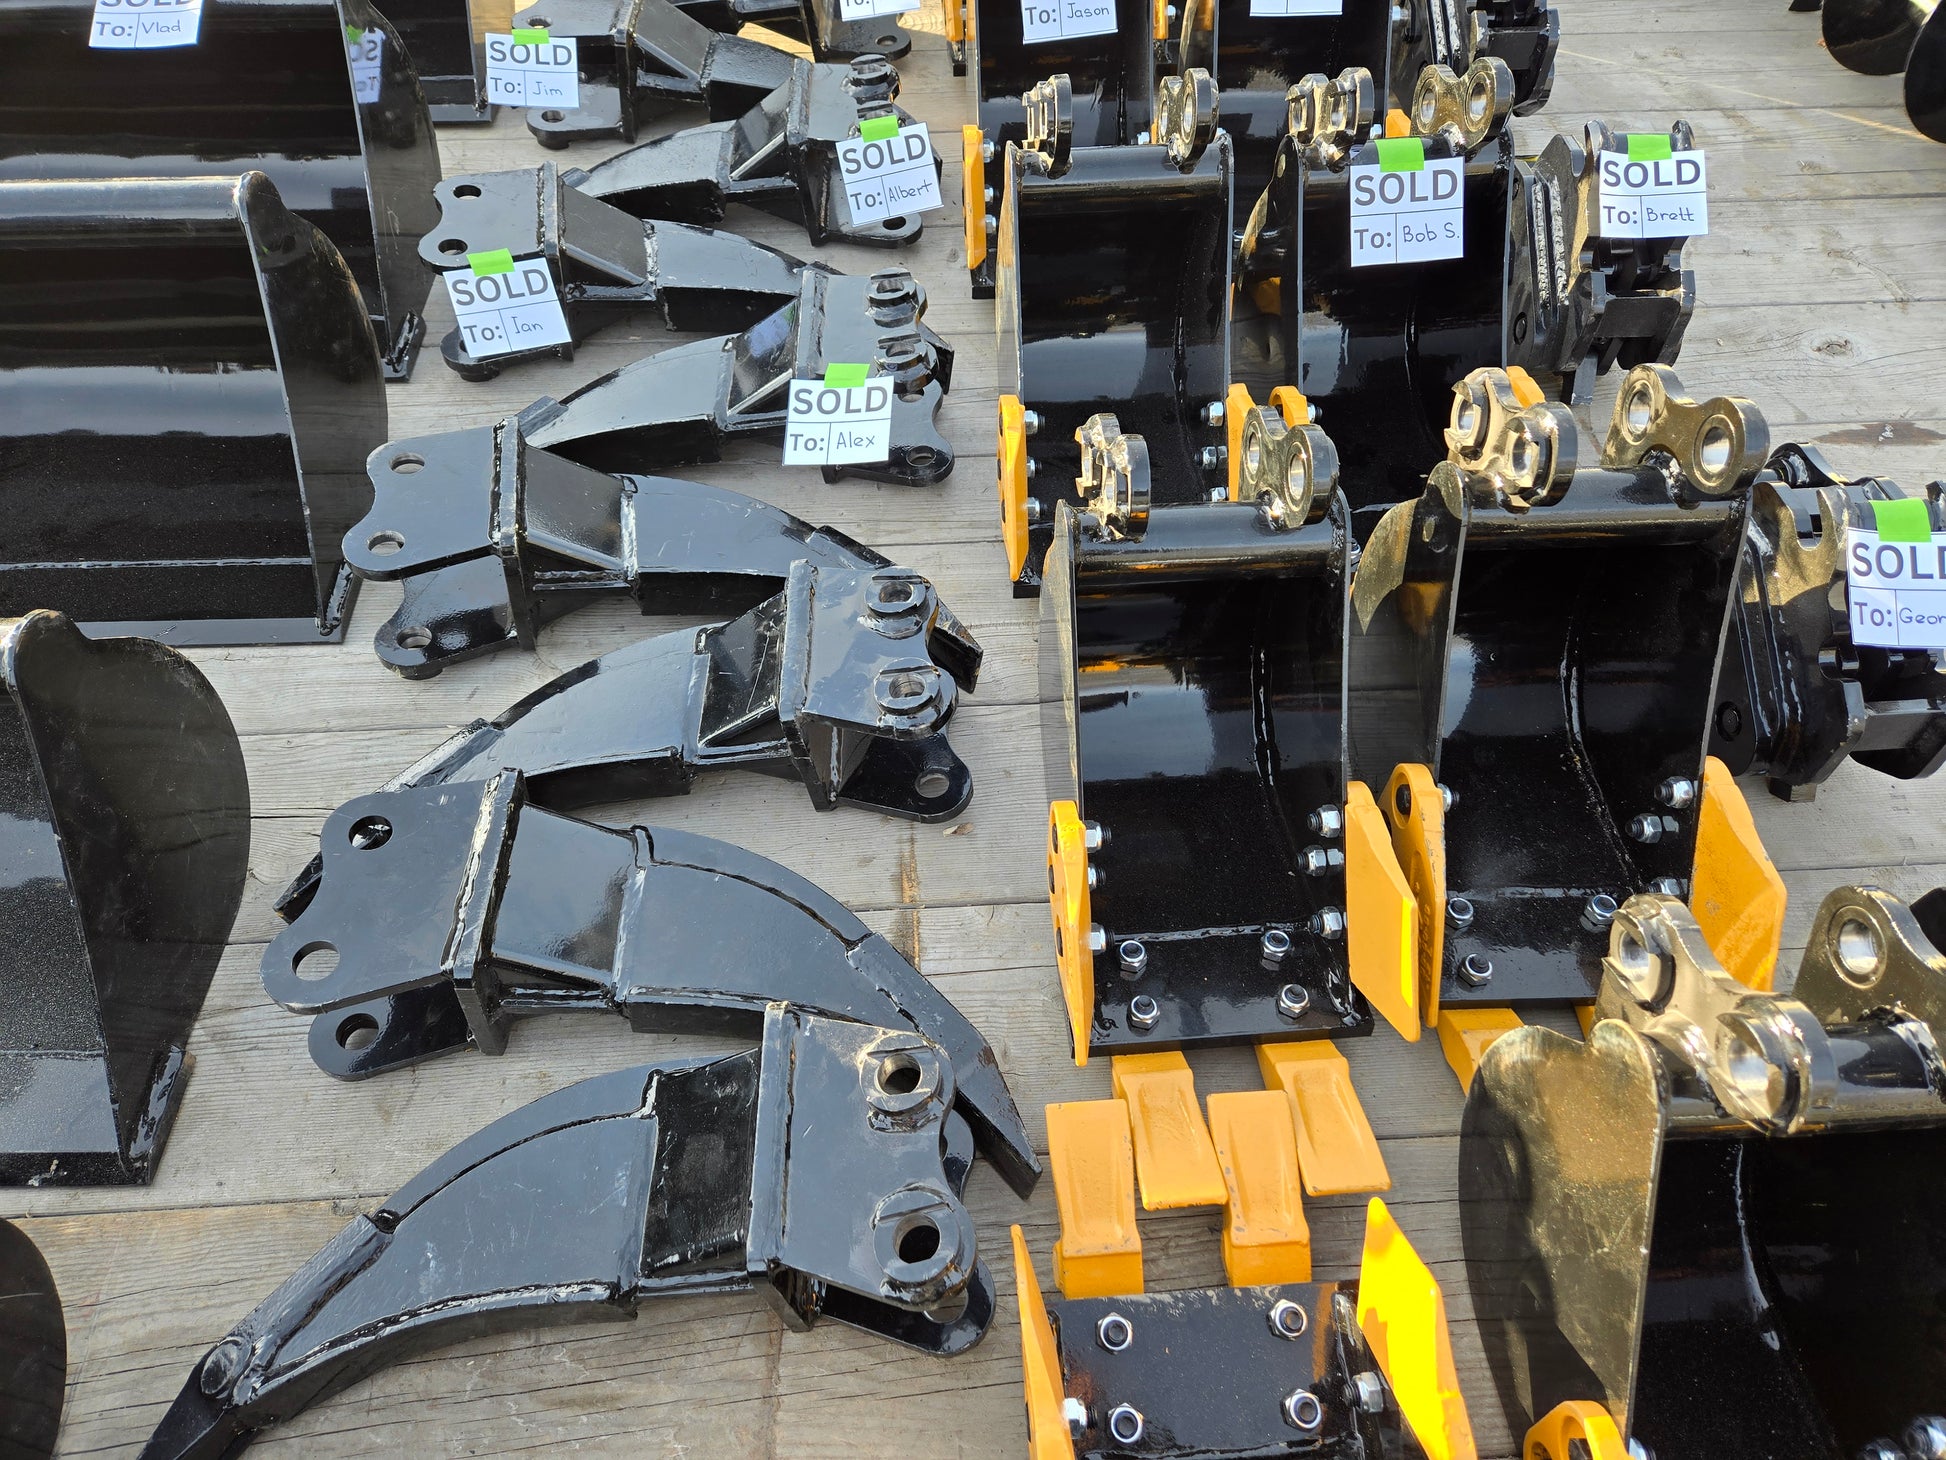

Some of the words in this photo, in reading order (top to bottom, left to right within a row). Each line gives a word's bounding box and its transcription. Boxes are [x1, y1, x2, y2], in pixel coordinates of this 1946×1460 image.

[96, 21, 133, 37] To:
[142, 19, 182, 34] Vlad
[1024, 6, 1057, 26] To:
[1067, 2, 1110, 19] Jason
[489, 40, 572, 66] SOLD
[490, 76, 522, 94] To:
[532, 81, 563, 96] Jim
[842, 133, 927, 175] SOLD
[1354, 168, 1458, 206] SOLD
[1603, 159, 1701, 188] SOLD
[849, 191, 883, 211] To:
[888, 179, 933, 203] Albert
[1602, 205, 1638, 225] To:
[1646, 206, 1695, 222] Brett
[1354, 228, 1392, 250] To:
[1402, 222, 1437, 243] Bob
[1443, 221, 1460, 239] S.
[451, 268, 549, 307] SOLD
[463, 324, 503, 343] To:
[510, 316, 544, 334] Ian
[792, 385, 888, 415] SOLD
[789, 433, 825, 452] To:
[836, 430, 876, 450] Alex
[1853, 600, 1893, 628] To:
